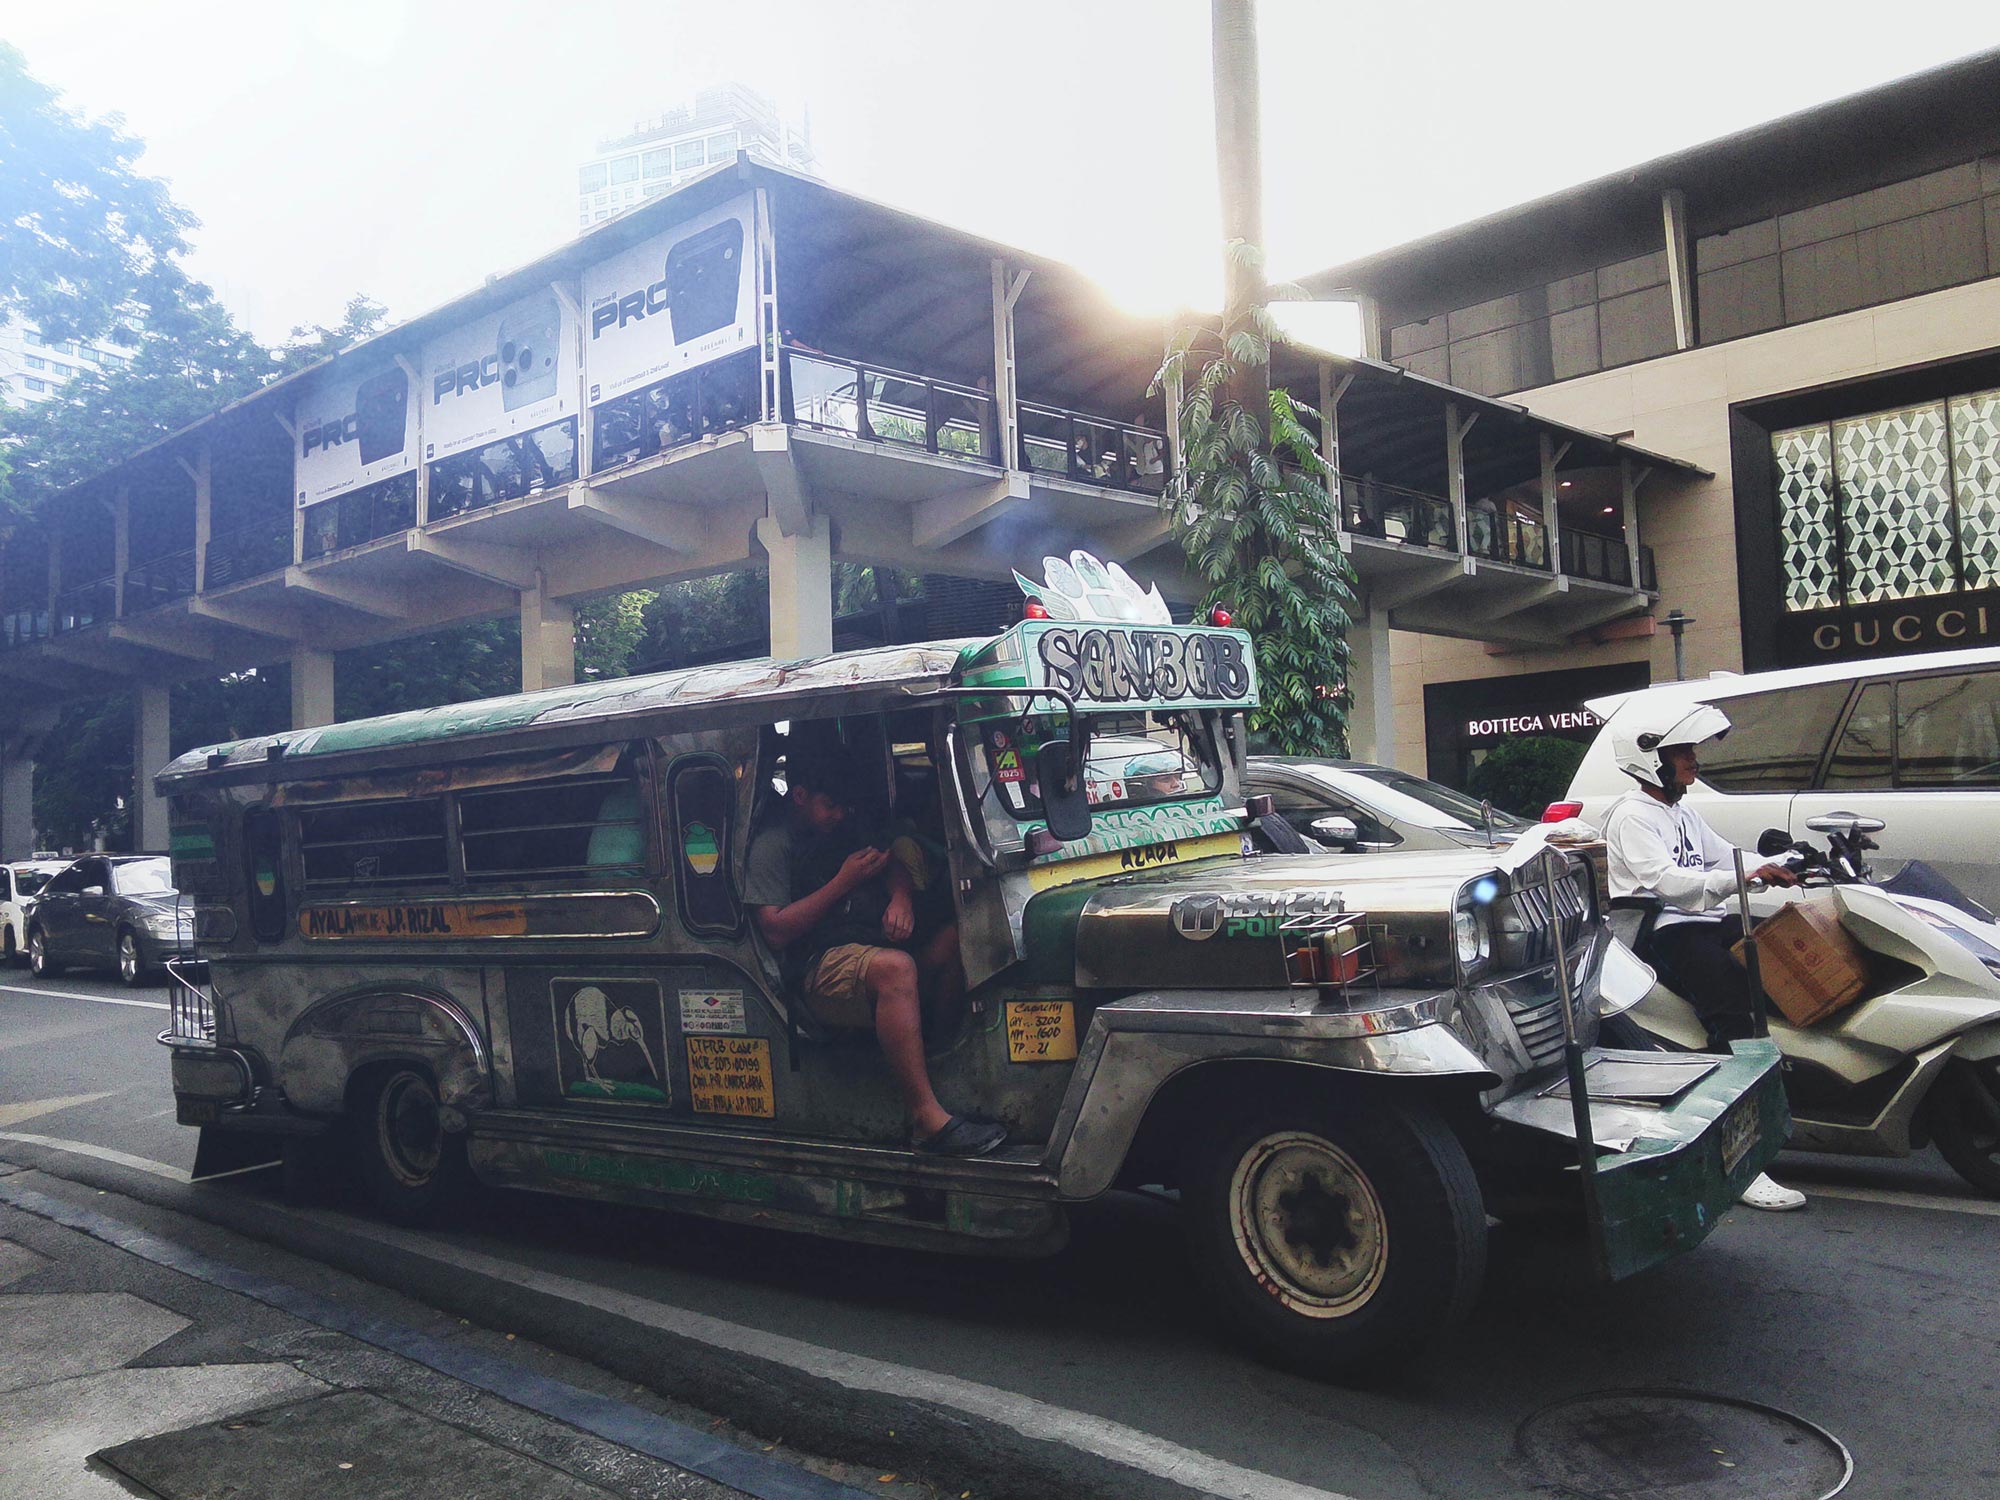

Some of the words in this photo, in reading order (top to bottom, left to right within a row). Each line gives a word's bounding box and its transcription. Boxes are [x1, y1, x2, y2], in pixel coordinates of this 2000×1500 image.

[1812, 606, 1988, 650] GUCCI
[1468, 716, 1544, 736] BOTTEGA
[1549, 711, 1604, 729] VENE
[1223, 891, 1345, 918] ISUZU
[309, 909, 354, 934] AYALA
[407, 907, 451, 933] RIZAL
[1035, 1016, 1061, 1027] 3200
